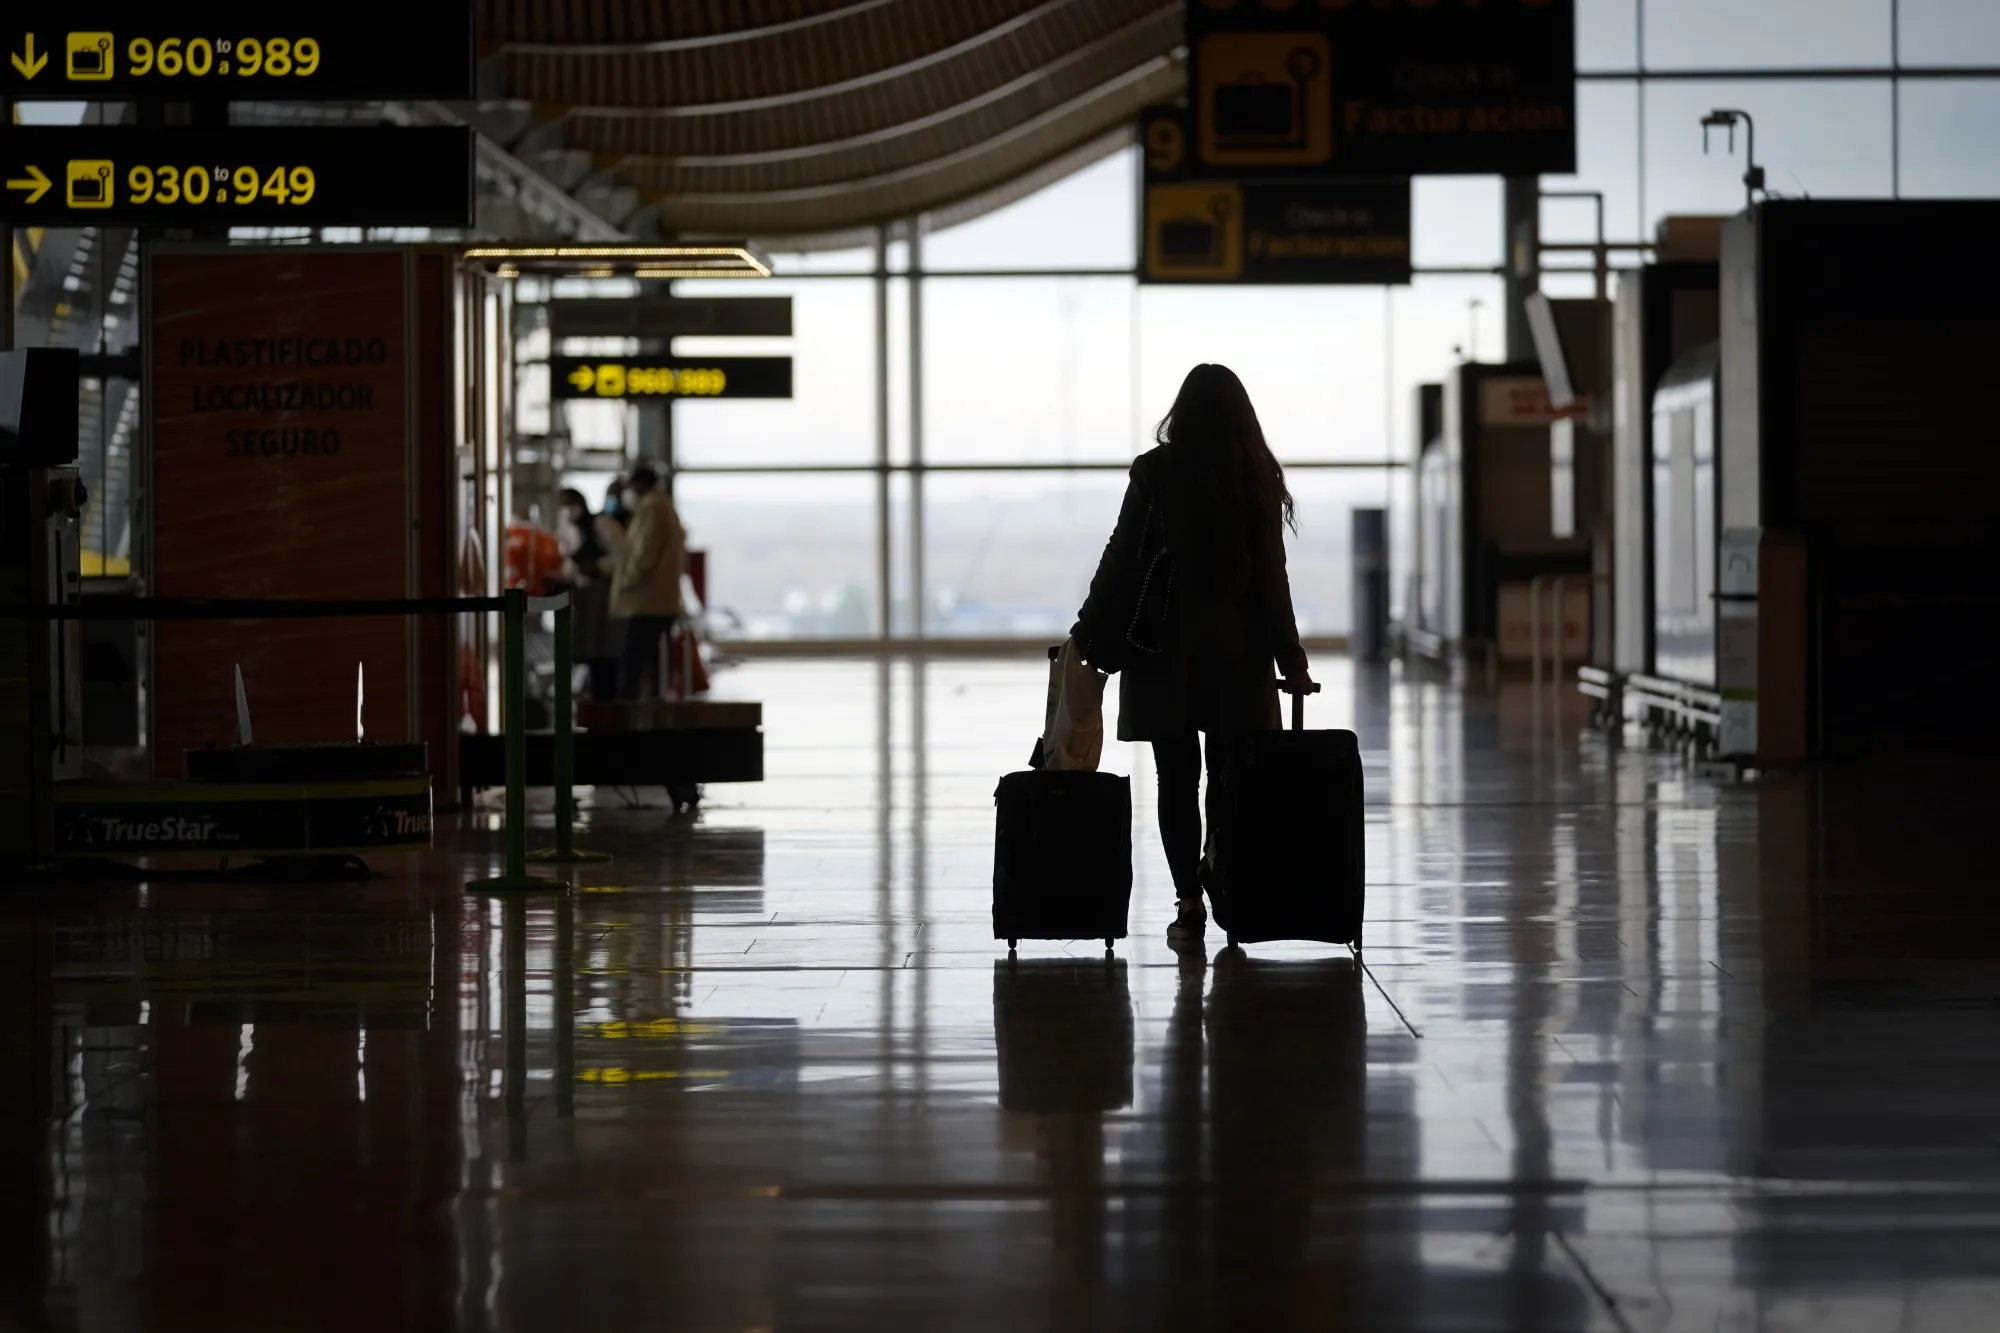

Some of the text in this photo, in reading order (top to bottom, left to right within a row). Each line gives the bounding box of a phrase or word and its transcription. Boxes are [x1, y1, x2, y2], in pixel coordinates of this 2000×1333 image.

[127, 36, 321, 77] 960 to a 989
[127, 164, 316, 205] 930 to a 949
[180, 338, 387, 366] PLASTIFICADO
[194, 384, 373, 411] LOCALIZADOR
[225, 428, 341, 456] SEGURO
[102, 815, 216, 842] TrueStar
[393, 807, 430, 835] True
